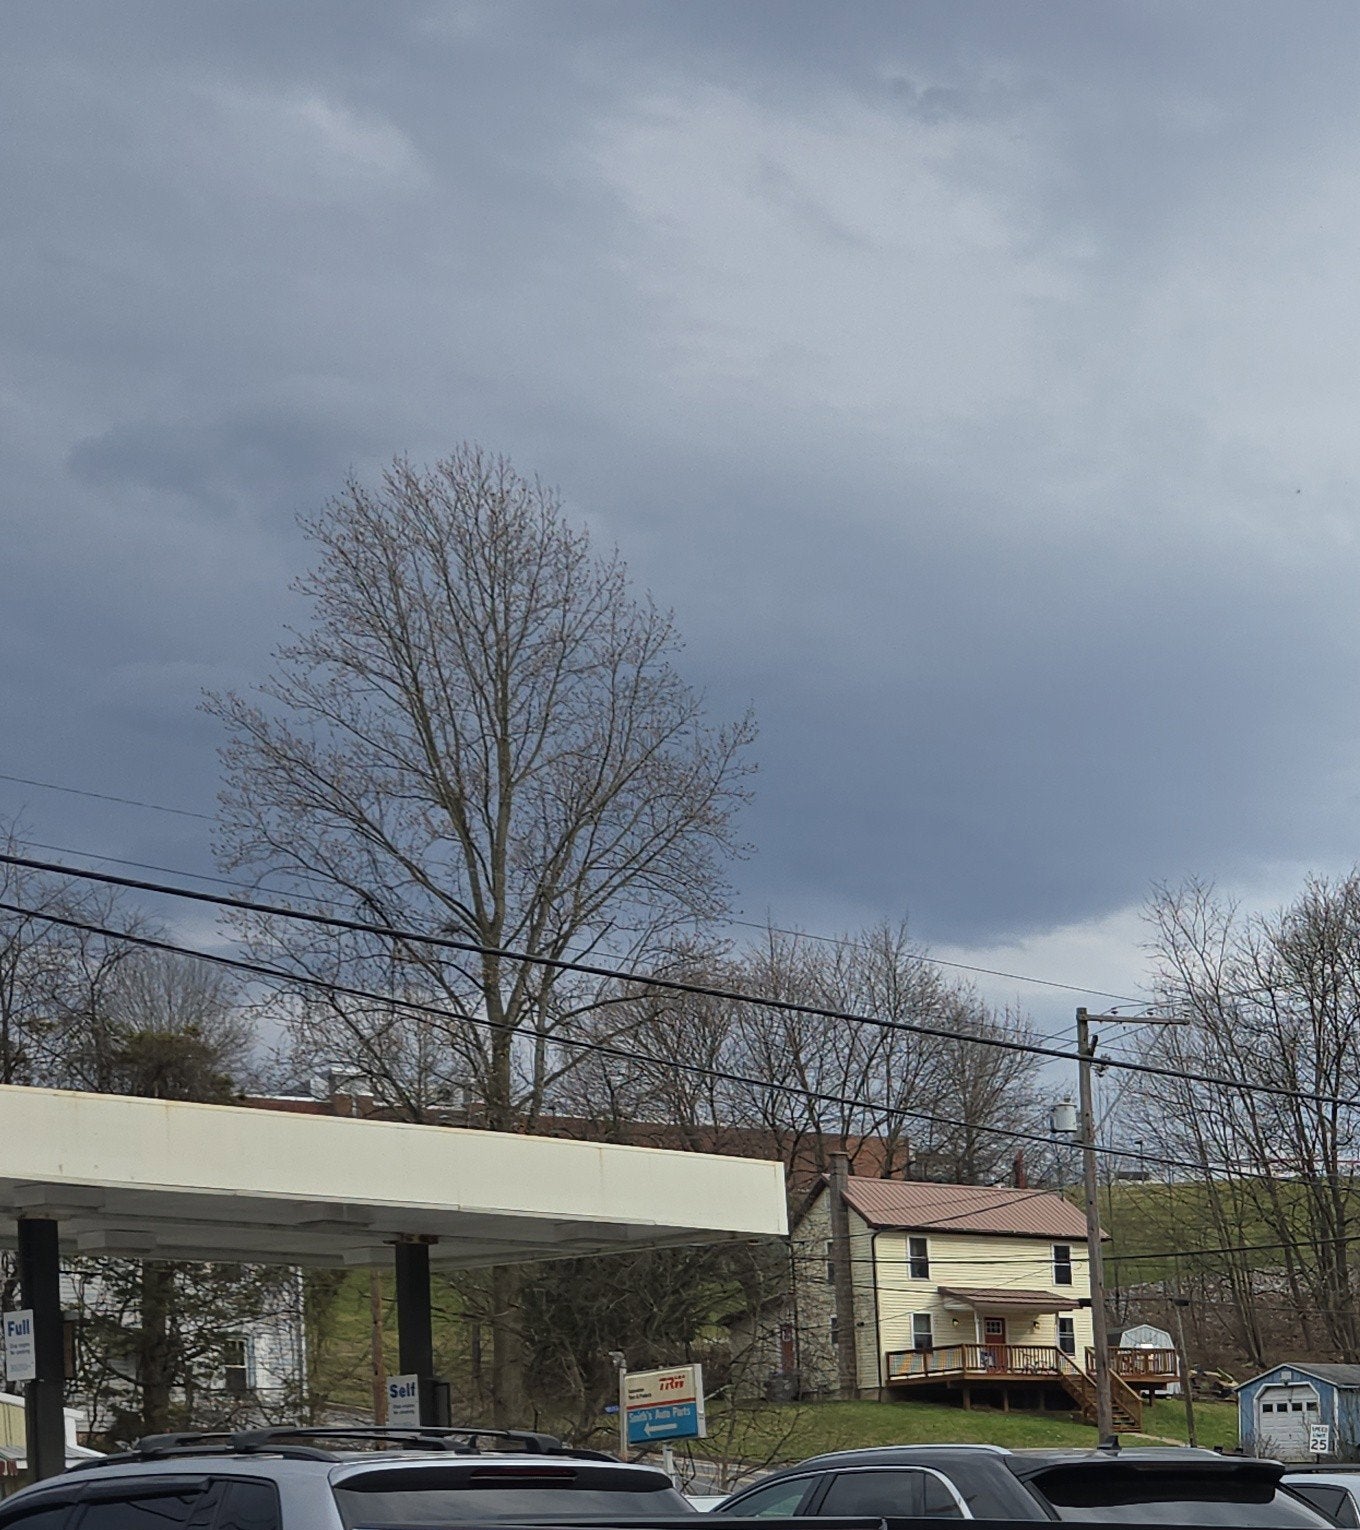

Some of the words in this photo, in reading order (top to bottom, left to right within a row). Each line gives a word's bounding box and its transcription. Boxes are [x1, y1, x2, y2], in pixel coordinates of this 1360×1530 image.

[7, 1319, 30, 1337] Full
[390, 1382, 415, 1398] Self
[1311, 1439, 1327, 1451] 25
